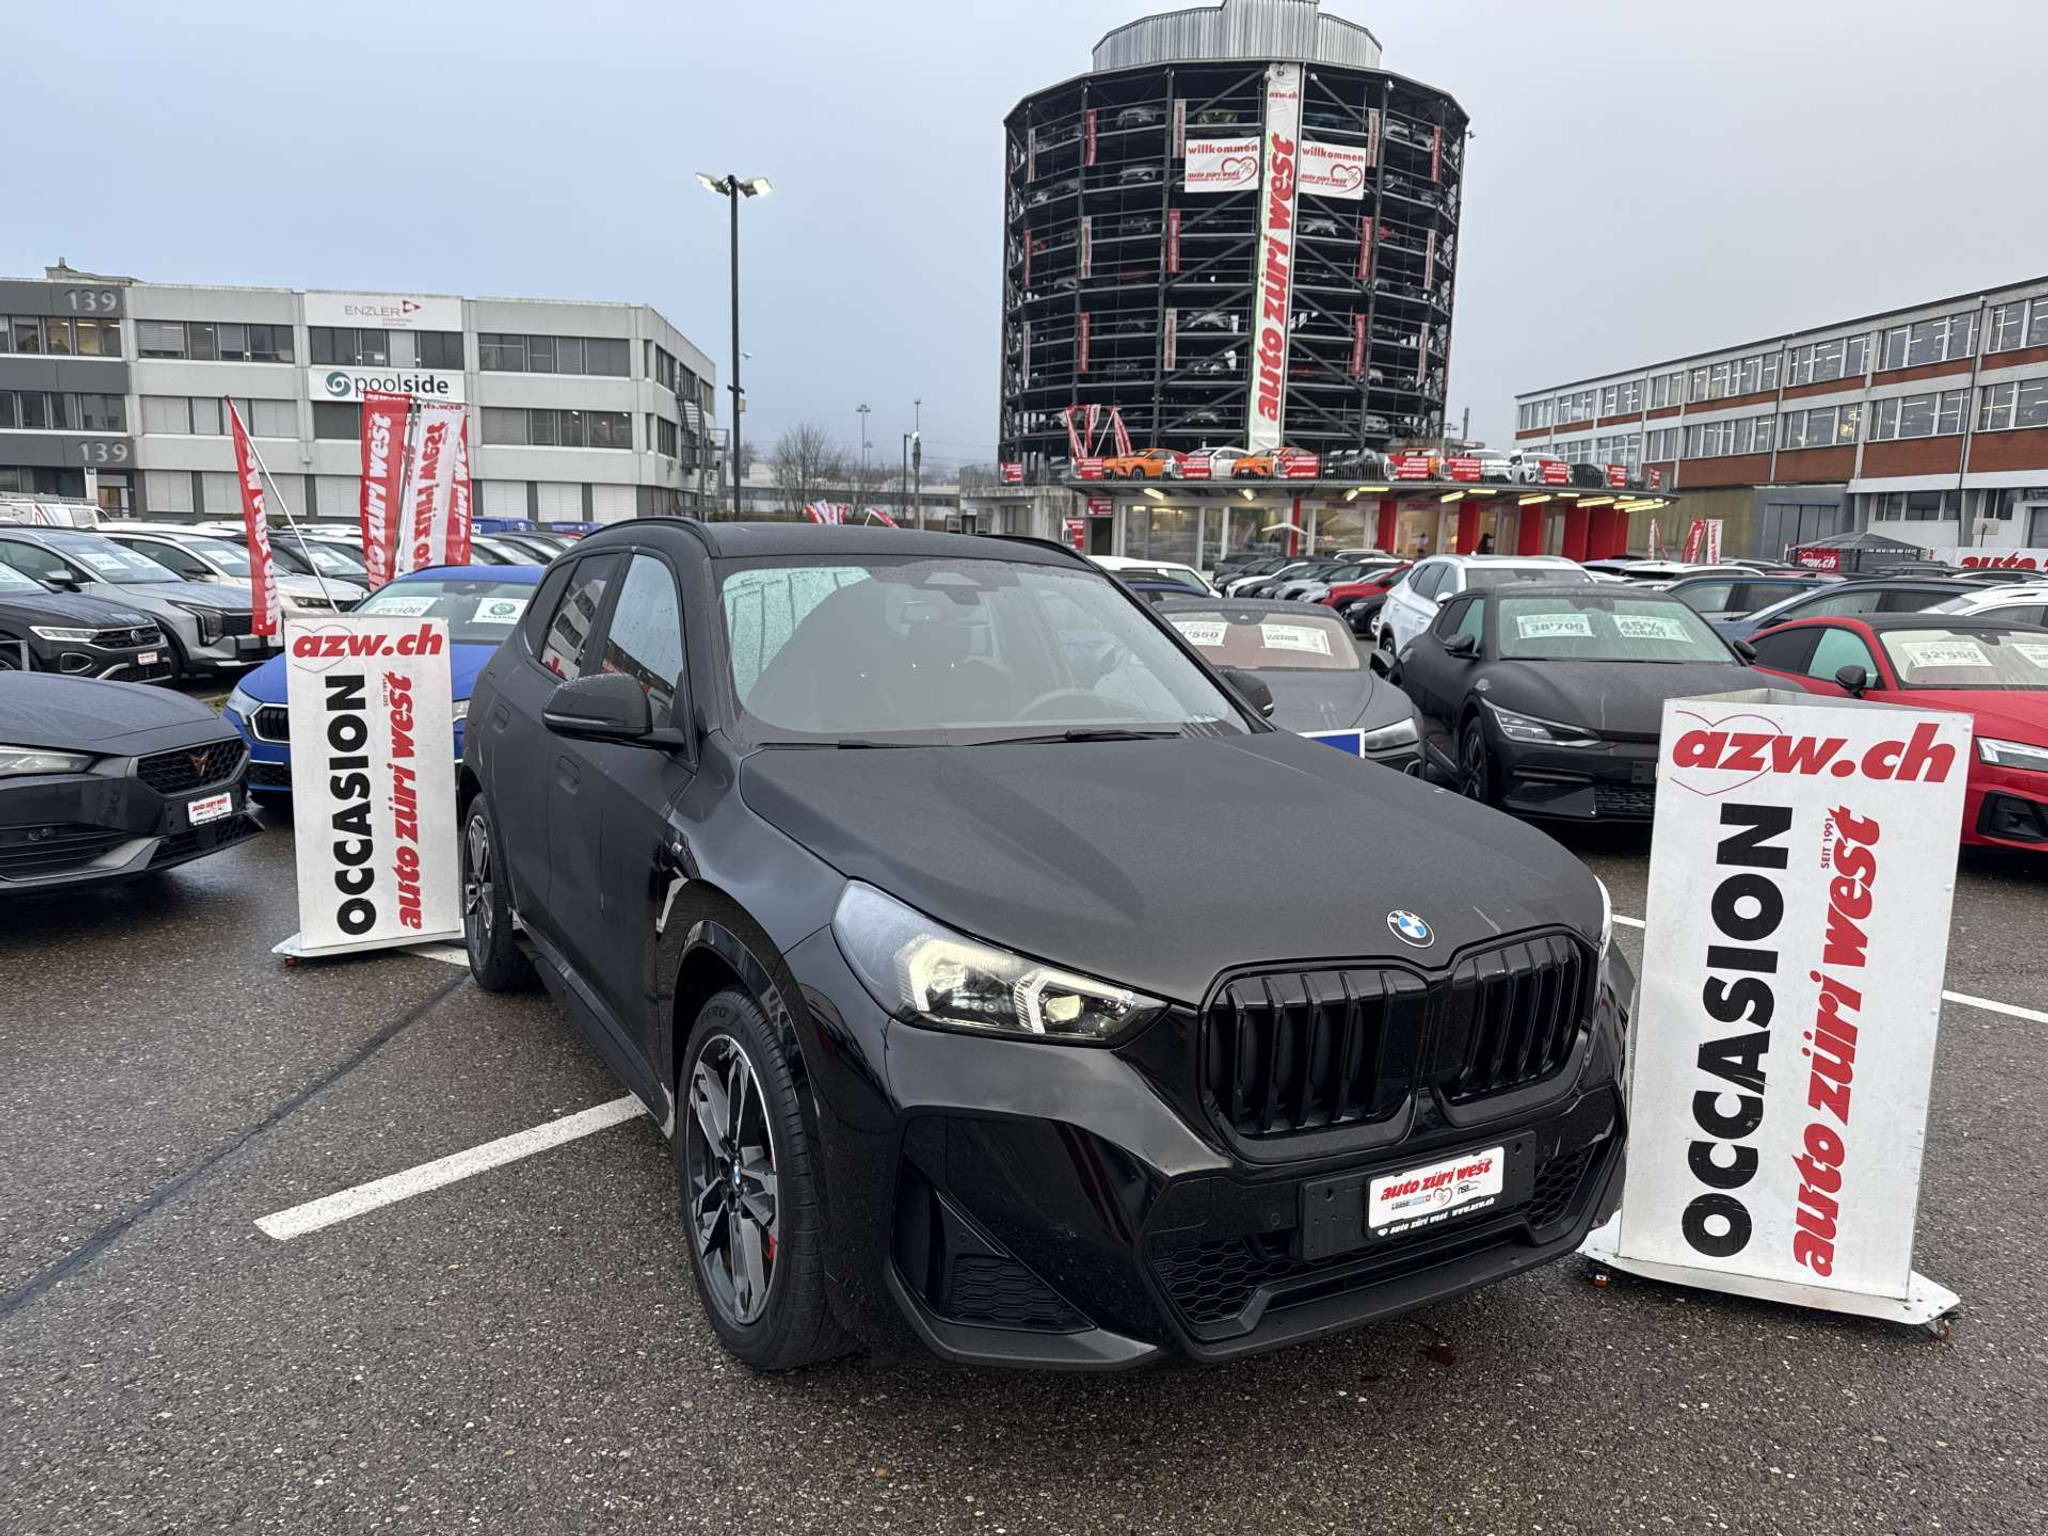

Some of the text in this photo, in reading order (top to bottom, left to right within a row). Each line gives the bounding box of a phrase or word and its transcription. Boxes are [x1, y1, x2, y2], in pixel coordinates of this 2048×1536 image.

[1188, 143, 1257, 155] willkommen
[1302, 147, 1364, 162] willkommen
[1258, 132, 1295, 421] auto züri west
[64, 289, 117, 312] 139
[344, 305, 400, 316] ENZLER
[355, 373, 449, 397] poolside
[78, 441, 128, 462] 139
[369, 412, 392, 478] west
[364, 479, 387, 544] züri
[293, 624, 443, 657] azw.ch
[1672, 723, 1957, 784] azw.ch
[325, 674, 377, 935] OCCASION
[385, 671, 423, 930] auto züri west
[1820, 817, 1833, 869] SEIT 1991
[1681, 802, 1794, 1258] OCCASION
[1791, 805, 1881, 1278] auto züri west
[1381, 1160, 1493, 1201] auto züri west
[1390, 1223, 1409, 1234] auto
[1429, 1212, 1448, 1223] west
